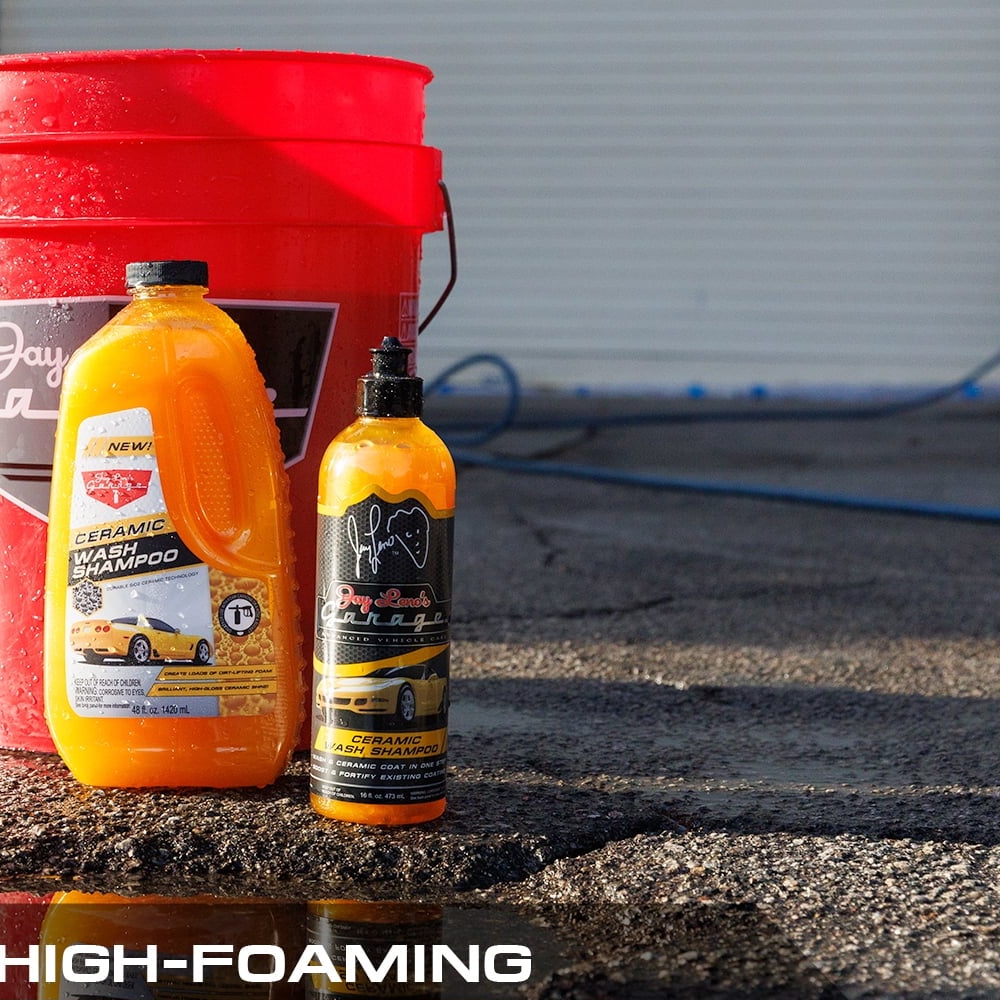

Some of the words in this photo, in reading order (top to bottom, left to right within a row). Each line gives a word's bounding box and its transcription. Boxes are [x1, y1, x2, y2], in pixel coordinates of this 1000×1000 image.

[108, 441, 153, 451] NEW!
[75, 518, 166, 545] CERAMIC
[73, 541, 138, 565] WASH
[72, 548, 179, 579] SHAMPOO
[165, 571, 199, 582] TECHNOLOGY
[335, 584, 373, 615] Jay
[374, 588, 431, 609] Leno's
[99, 679, 113, 687] REACH
[113, 679, 120, 687] OF
[98, 688, 124, 696] CORROSIVE
[131, 705, 140, 714] 48
[161, 704, 178, 715] 1420
[179, 704, 190, 714] mL
[351, 735, 422, 745] CERAMIC
[370, 744, 439, 756] SHAMPOO
[335, 760, 377, 770] CERAMIC
[420, 761, 435, 769] ONE
[338, 771, 377, 780] FORTIFY
